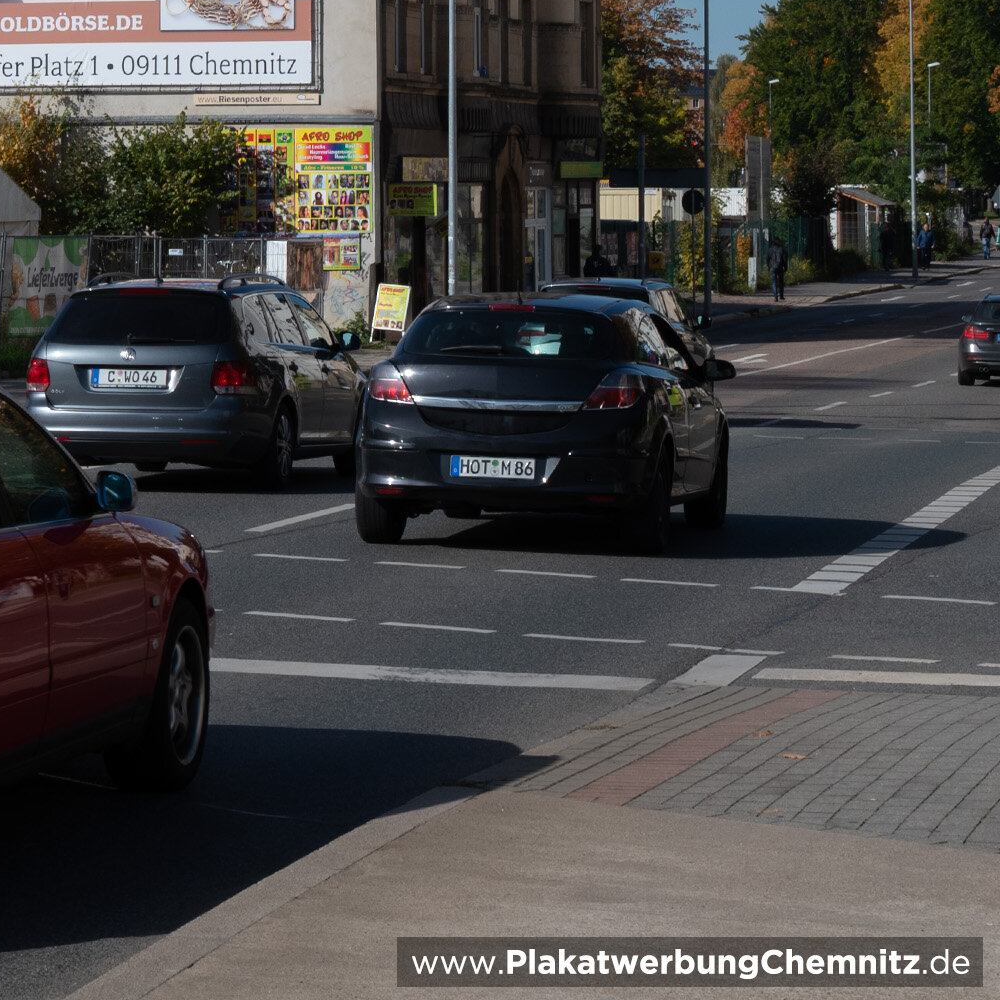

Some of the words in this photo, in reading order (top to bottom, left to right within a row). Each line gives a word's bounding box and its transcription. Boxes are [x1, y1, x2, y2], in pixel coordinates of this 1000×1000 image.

[31, 53, 84, 77] Platz
[91, 55, 98, 76] 1
[121, 54, 182, 76] 09111
[189, 51, 298, 76] Chemnitz
[302, 131, 330, 142] AFRO
[335, 130, 363, 142] SHOP
[27, 266, 79, 293] LieferZwerge
[107, 370, 115, 383] C
[124, 370, 140, 383] WO
[142, 371, 157, 383] 46
[460, 459, 490, 475] HOT
[501, 460, 511, 476] M
[514, 461, 533, 476] 86
